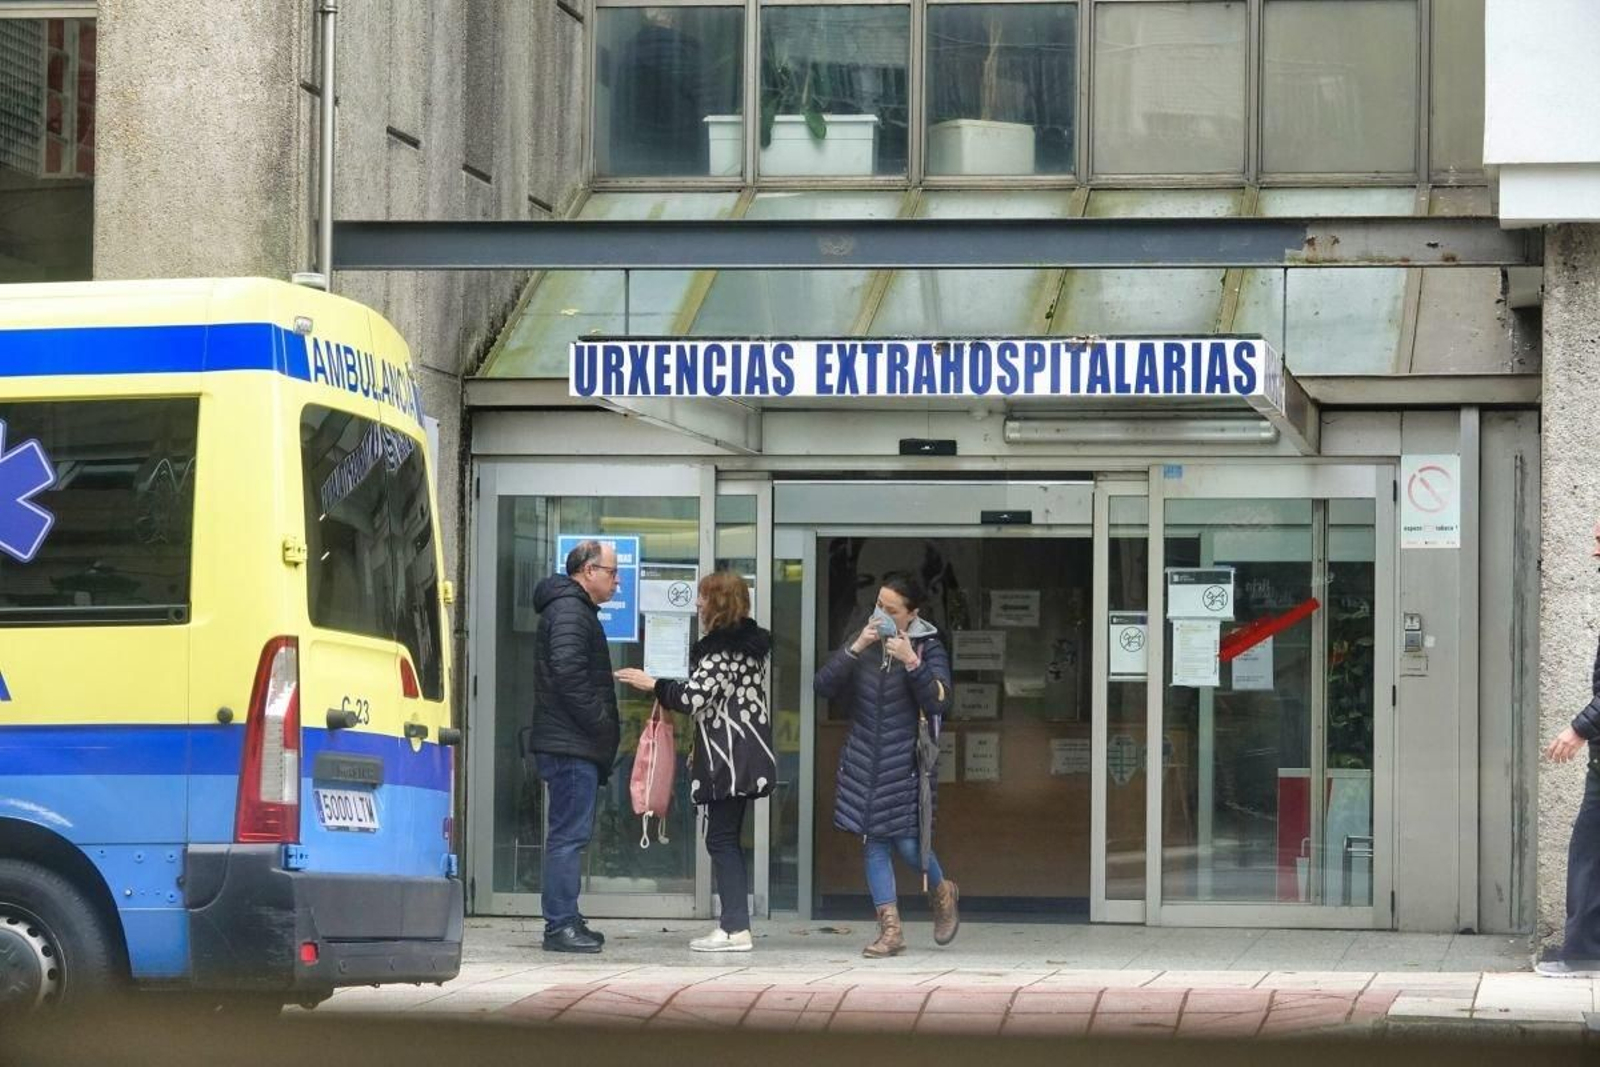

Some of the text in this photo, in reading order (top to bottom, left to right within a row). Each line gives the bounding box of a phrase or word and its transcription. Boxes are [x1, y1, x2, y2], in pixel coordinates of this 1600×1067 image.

[575, 343, 795, 396] URXENCIAS
[816, 341, 1257, 396] EXTRAHOSPITALARIAS
[356, 698, 369, 725] 23
[323, 794, 354, 821] 5000
